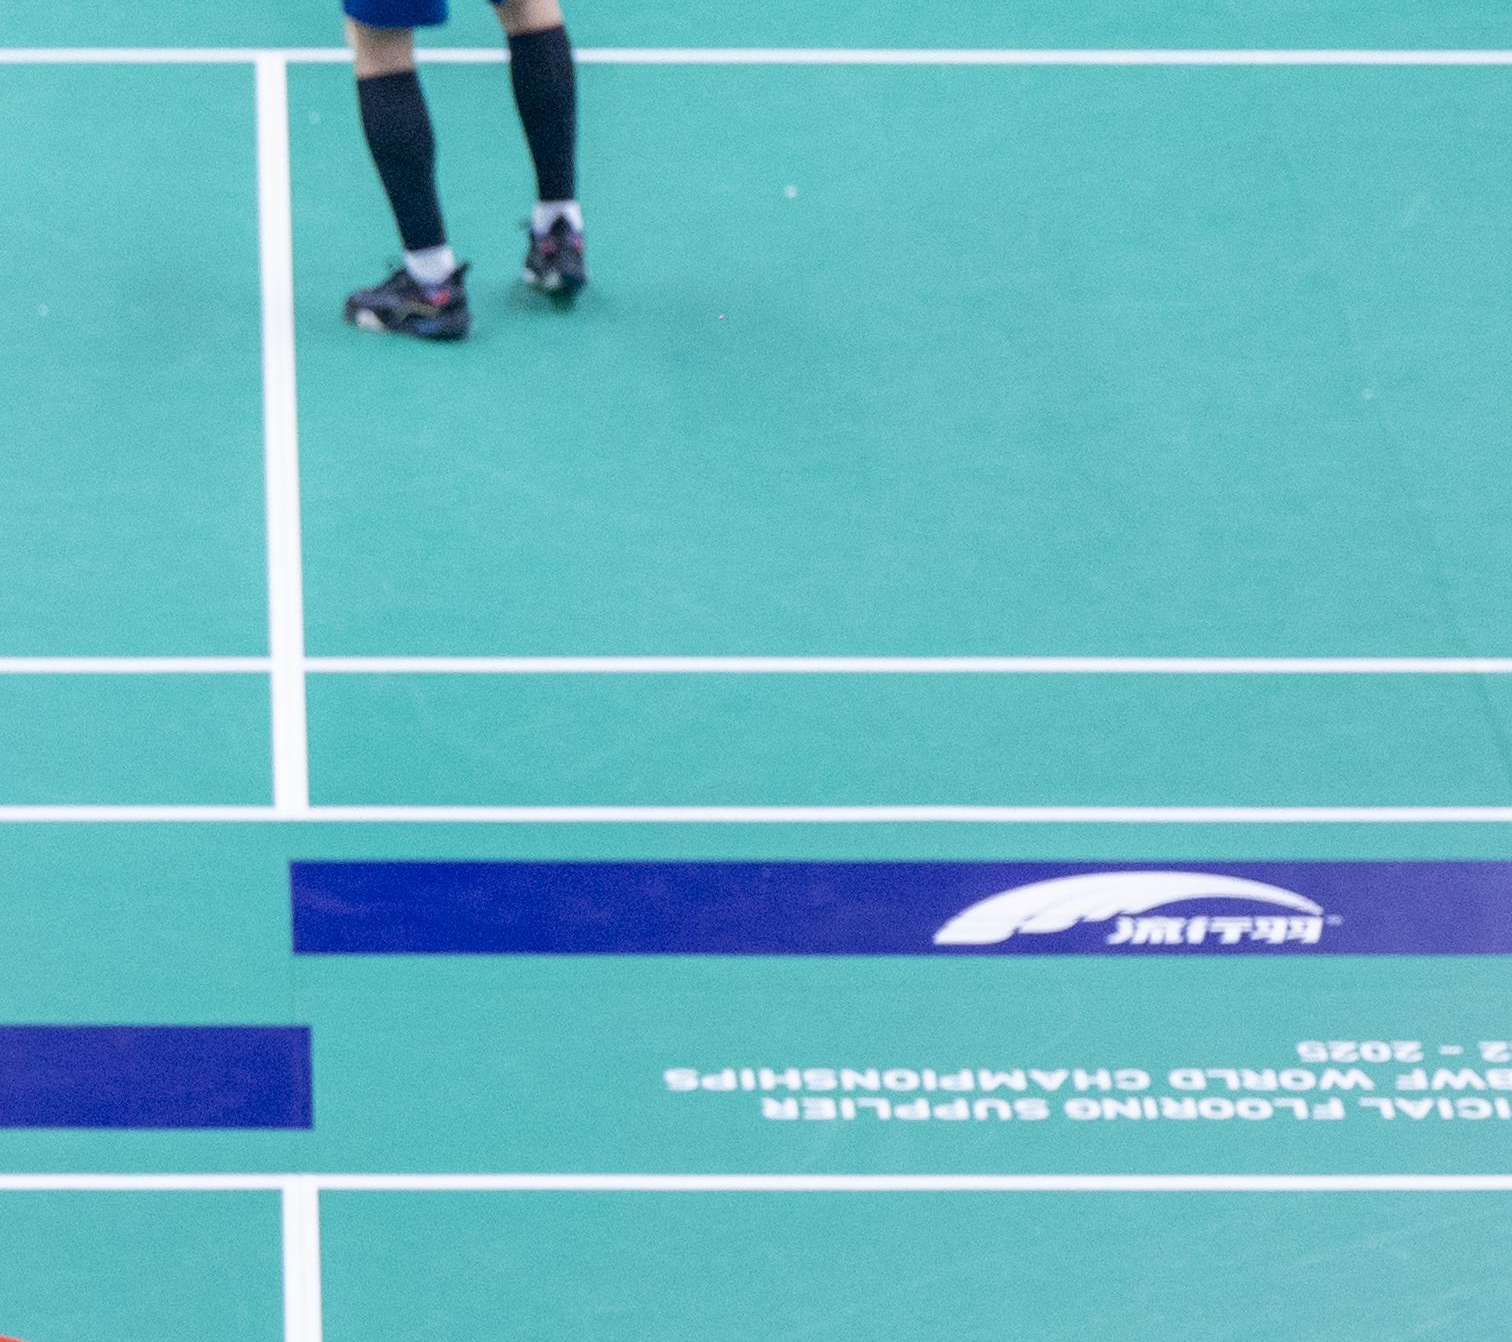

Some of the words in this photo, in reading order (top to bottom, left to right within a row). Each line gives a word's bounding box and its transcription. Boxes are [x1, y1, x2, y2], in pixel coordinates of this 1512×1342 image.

[1296, 1040, 1425, 1064] 2025
[663, 1067, 1151, 1092] CHAMPIONSHIPS
[1168, 1067, 1376, 1092] WORLD
[761, 1096, 1050, 1121] SUPPLIER
[1063, 1096, 1347, 1121] FLOORING
